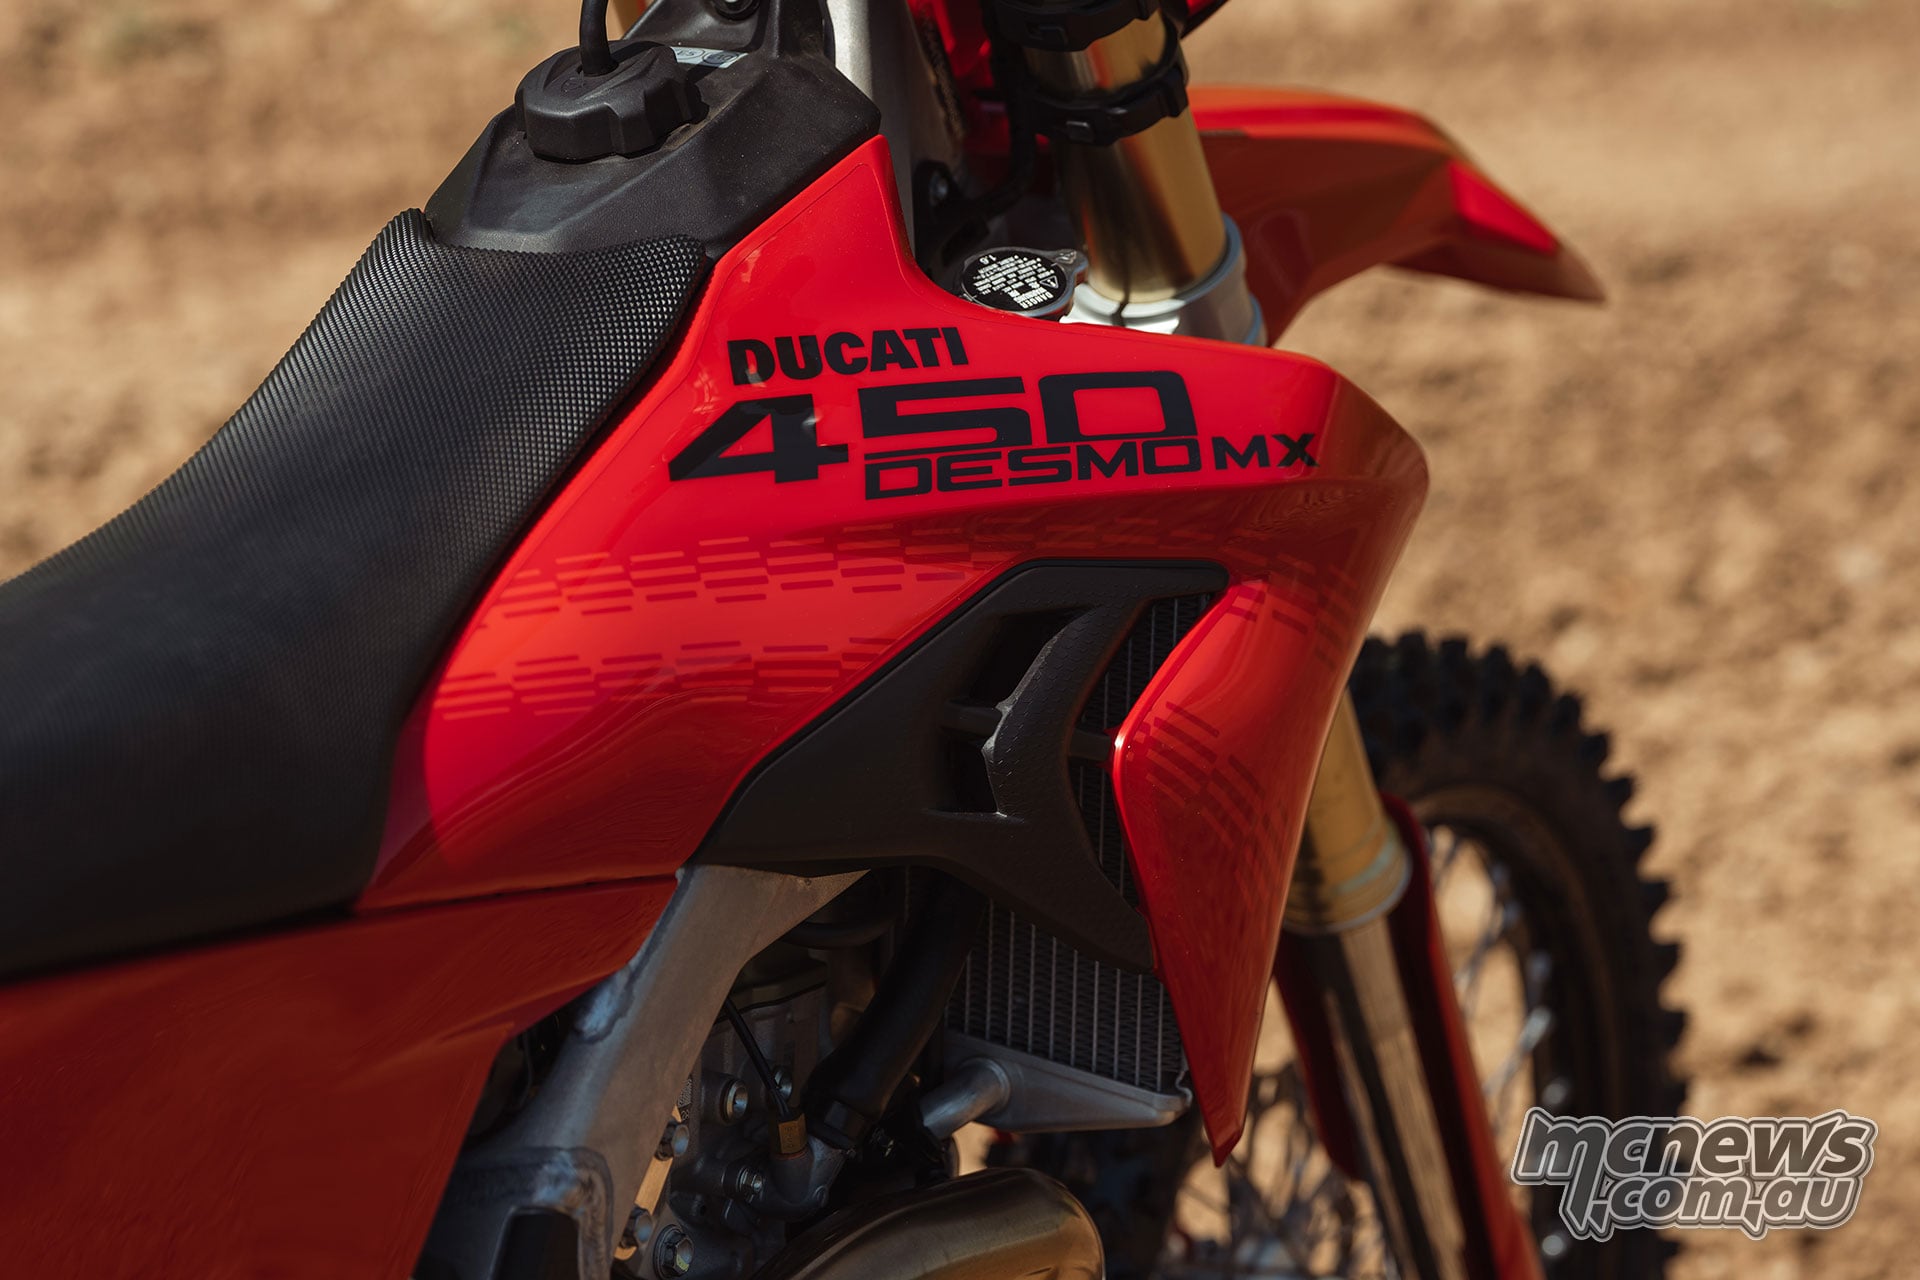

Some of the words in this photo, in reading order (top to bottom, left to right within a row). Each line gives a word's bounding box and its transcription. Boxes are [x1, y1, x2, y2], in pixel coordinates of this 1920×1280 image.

[1020, 291, 1054, 309] DANGER
[727, 327, 968, 386] DUCATI
[668, 371, 1199, 483] 450
[864, 438, 1202, 500] DESMO
[1212, 433, 1319, 470] MX
